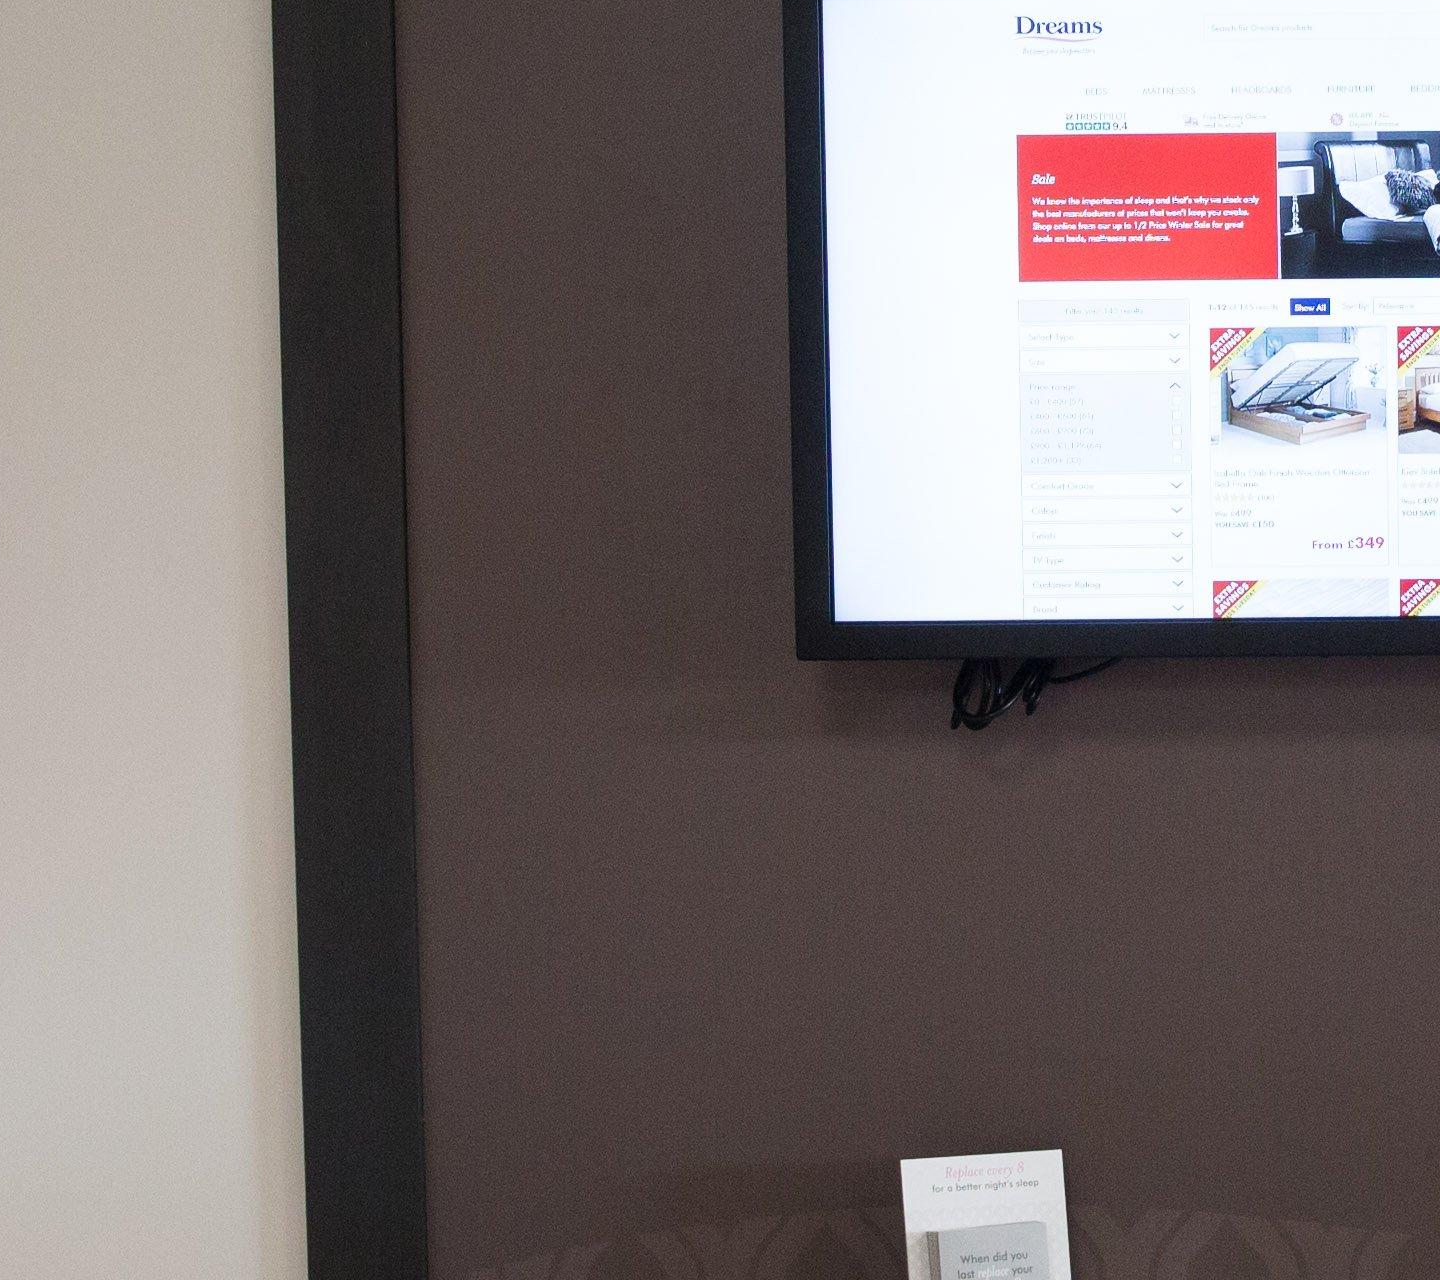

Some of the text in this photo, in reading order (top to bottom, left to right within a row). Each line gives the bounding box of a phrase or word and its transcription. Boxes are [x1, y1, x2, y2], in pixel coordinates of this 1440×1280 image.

[1014, 15, 1103, 35] Dreams
[1112, 122, 1128, 131] 9.4
[1294, 303, 1327, 313] Show All
[1210, 327, 1236, 352] EXTRA
[1212, 328, 1247, 363] SAVINGS
[1398, 325, 1424, 350] EXTRA
[1399, 327, 1435, 362] SAVINGS
[1312, 536, 1385, 550] From £349
[945, 1161, 1025, 1182] Replace every 8
[932, 1178, 1040, 1193] for better night's sleep
[960, 1251, 1028, 1265] When did you
[957, 1269, 975, 1280] last
[1011, 1265, 1034, 1277] your
